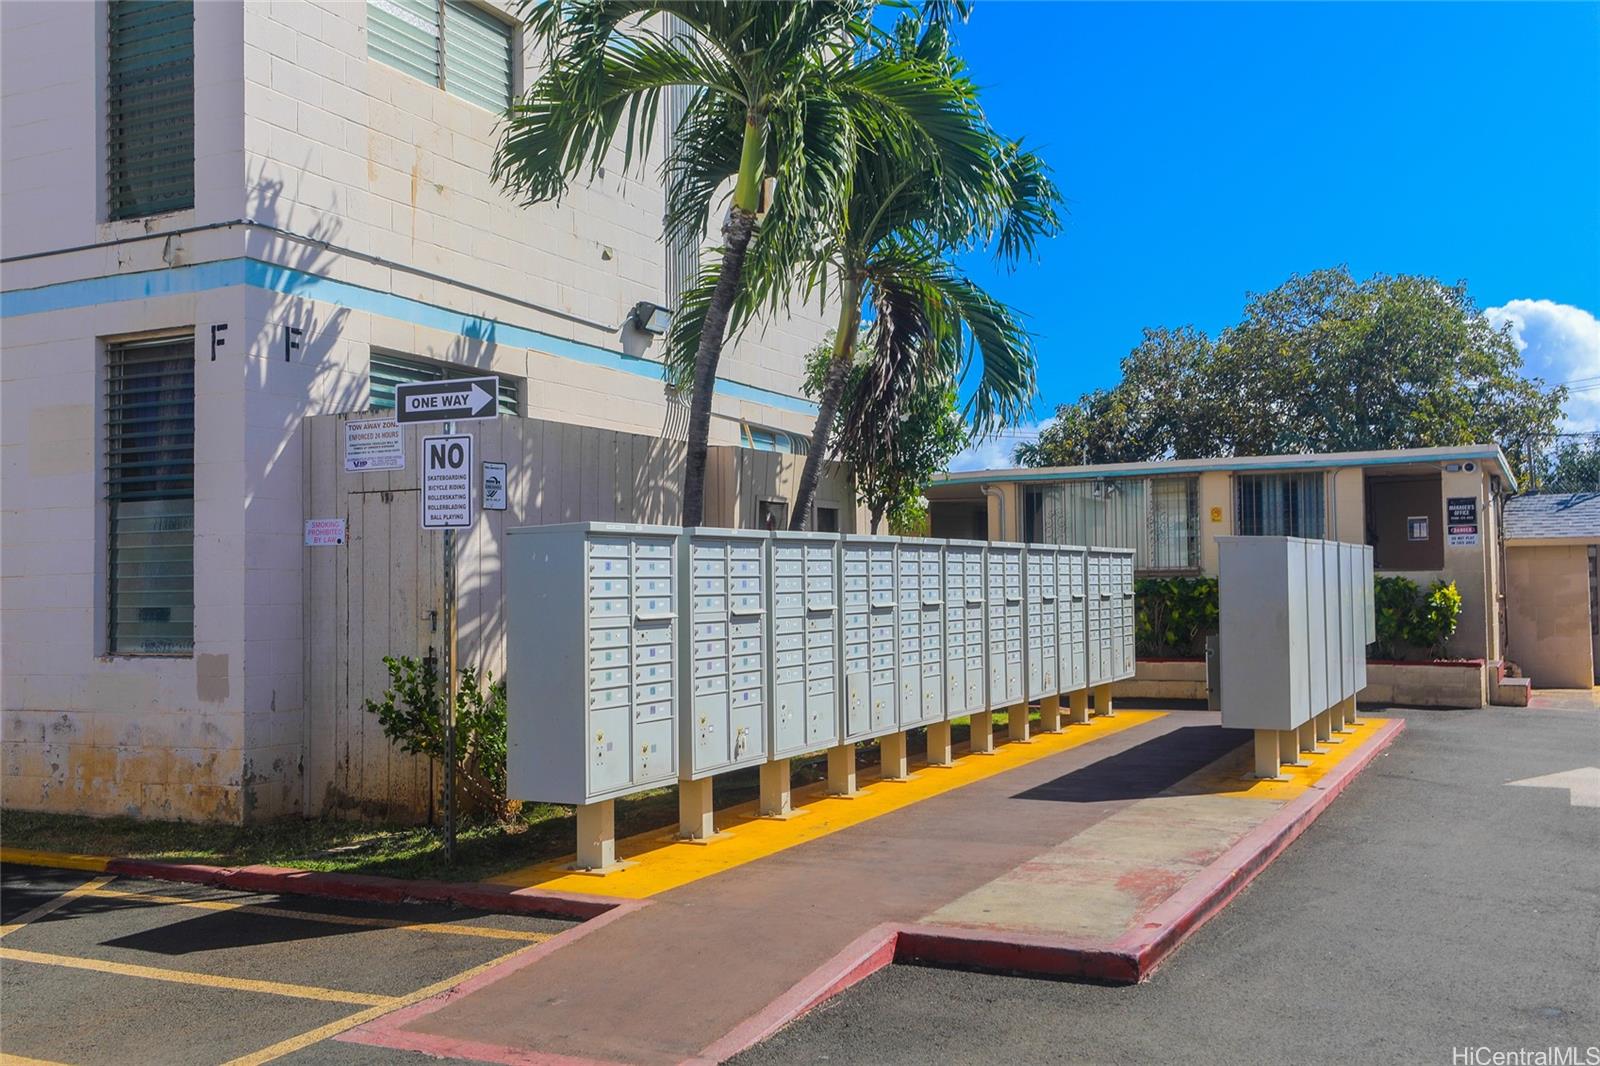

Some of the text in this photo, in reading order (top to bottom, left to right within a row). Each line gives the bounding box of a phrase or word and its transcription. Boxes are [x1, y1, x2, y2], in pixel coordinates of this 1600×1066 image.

[211, 324, 228, 361] F
[285, 326, 303, 362] F
[411, 394, 470, 409] ONE WAY
[363, 422, 381, 430] AWAY
[382, 421, 399, 429] ZON
[349, 432, 374, 441] ENFORCED
[382, 431, 399, 439] HOURS
[430, 443, 464, 470] NO
[427, 474, 467, 482] SKATEBOARDING
[427, 503, 467, 511] ROLLERBLADING
